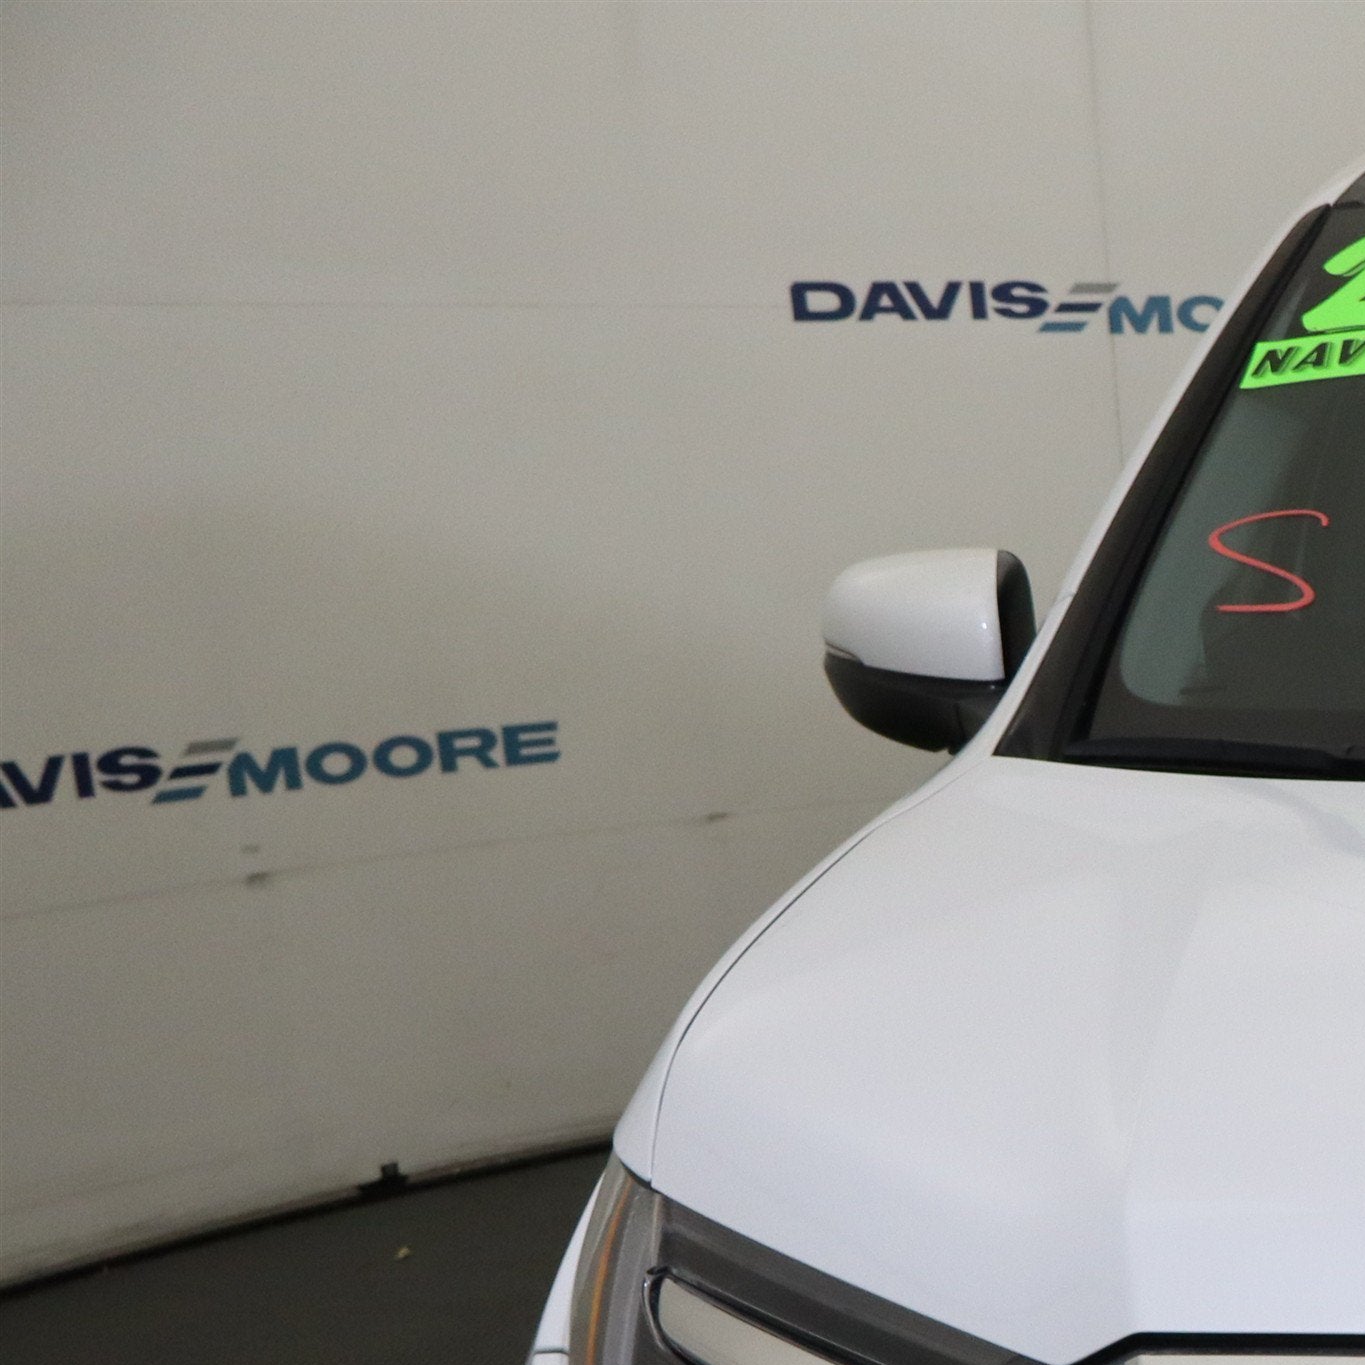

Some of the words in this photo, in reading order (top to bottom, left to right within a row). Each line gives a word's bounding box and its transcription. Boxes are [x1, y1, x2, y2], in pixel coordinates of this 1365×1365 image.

[789, 280, 1051, 322] DAVIS
[1208, 508, 1330, 613] S
[227, 720, 562, 798] MOORE
